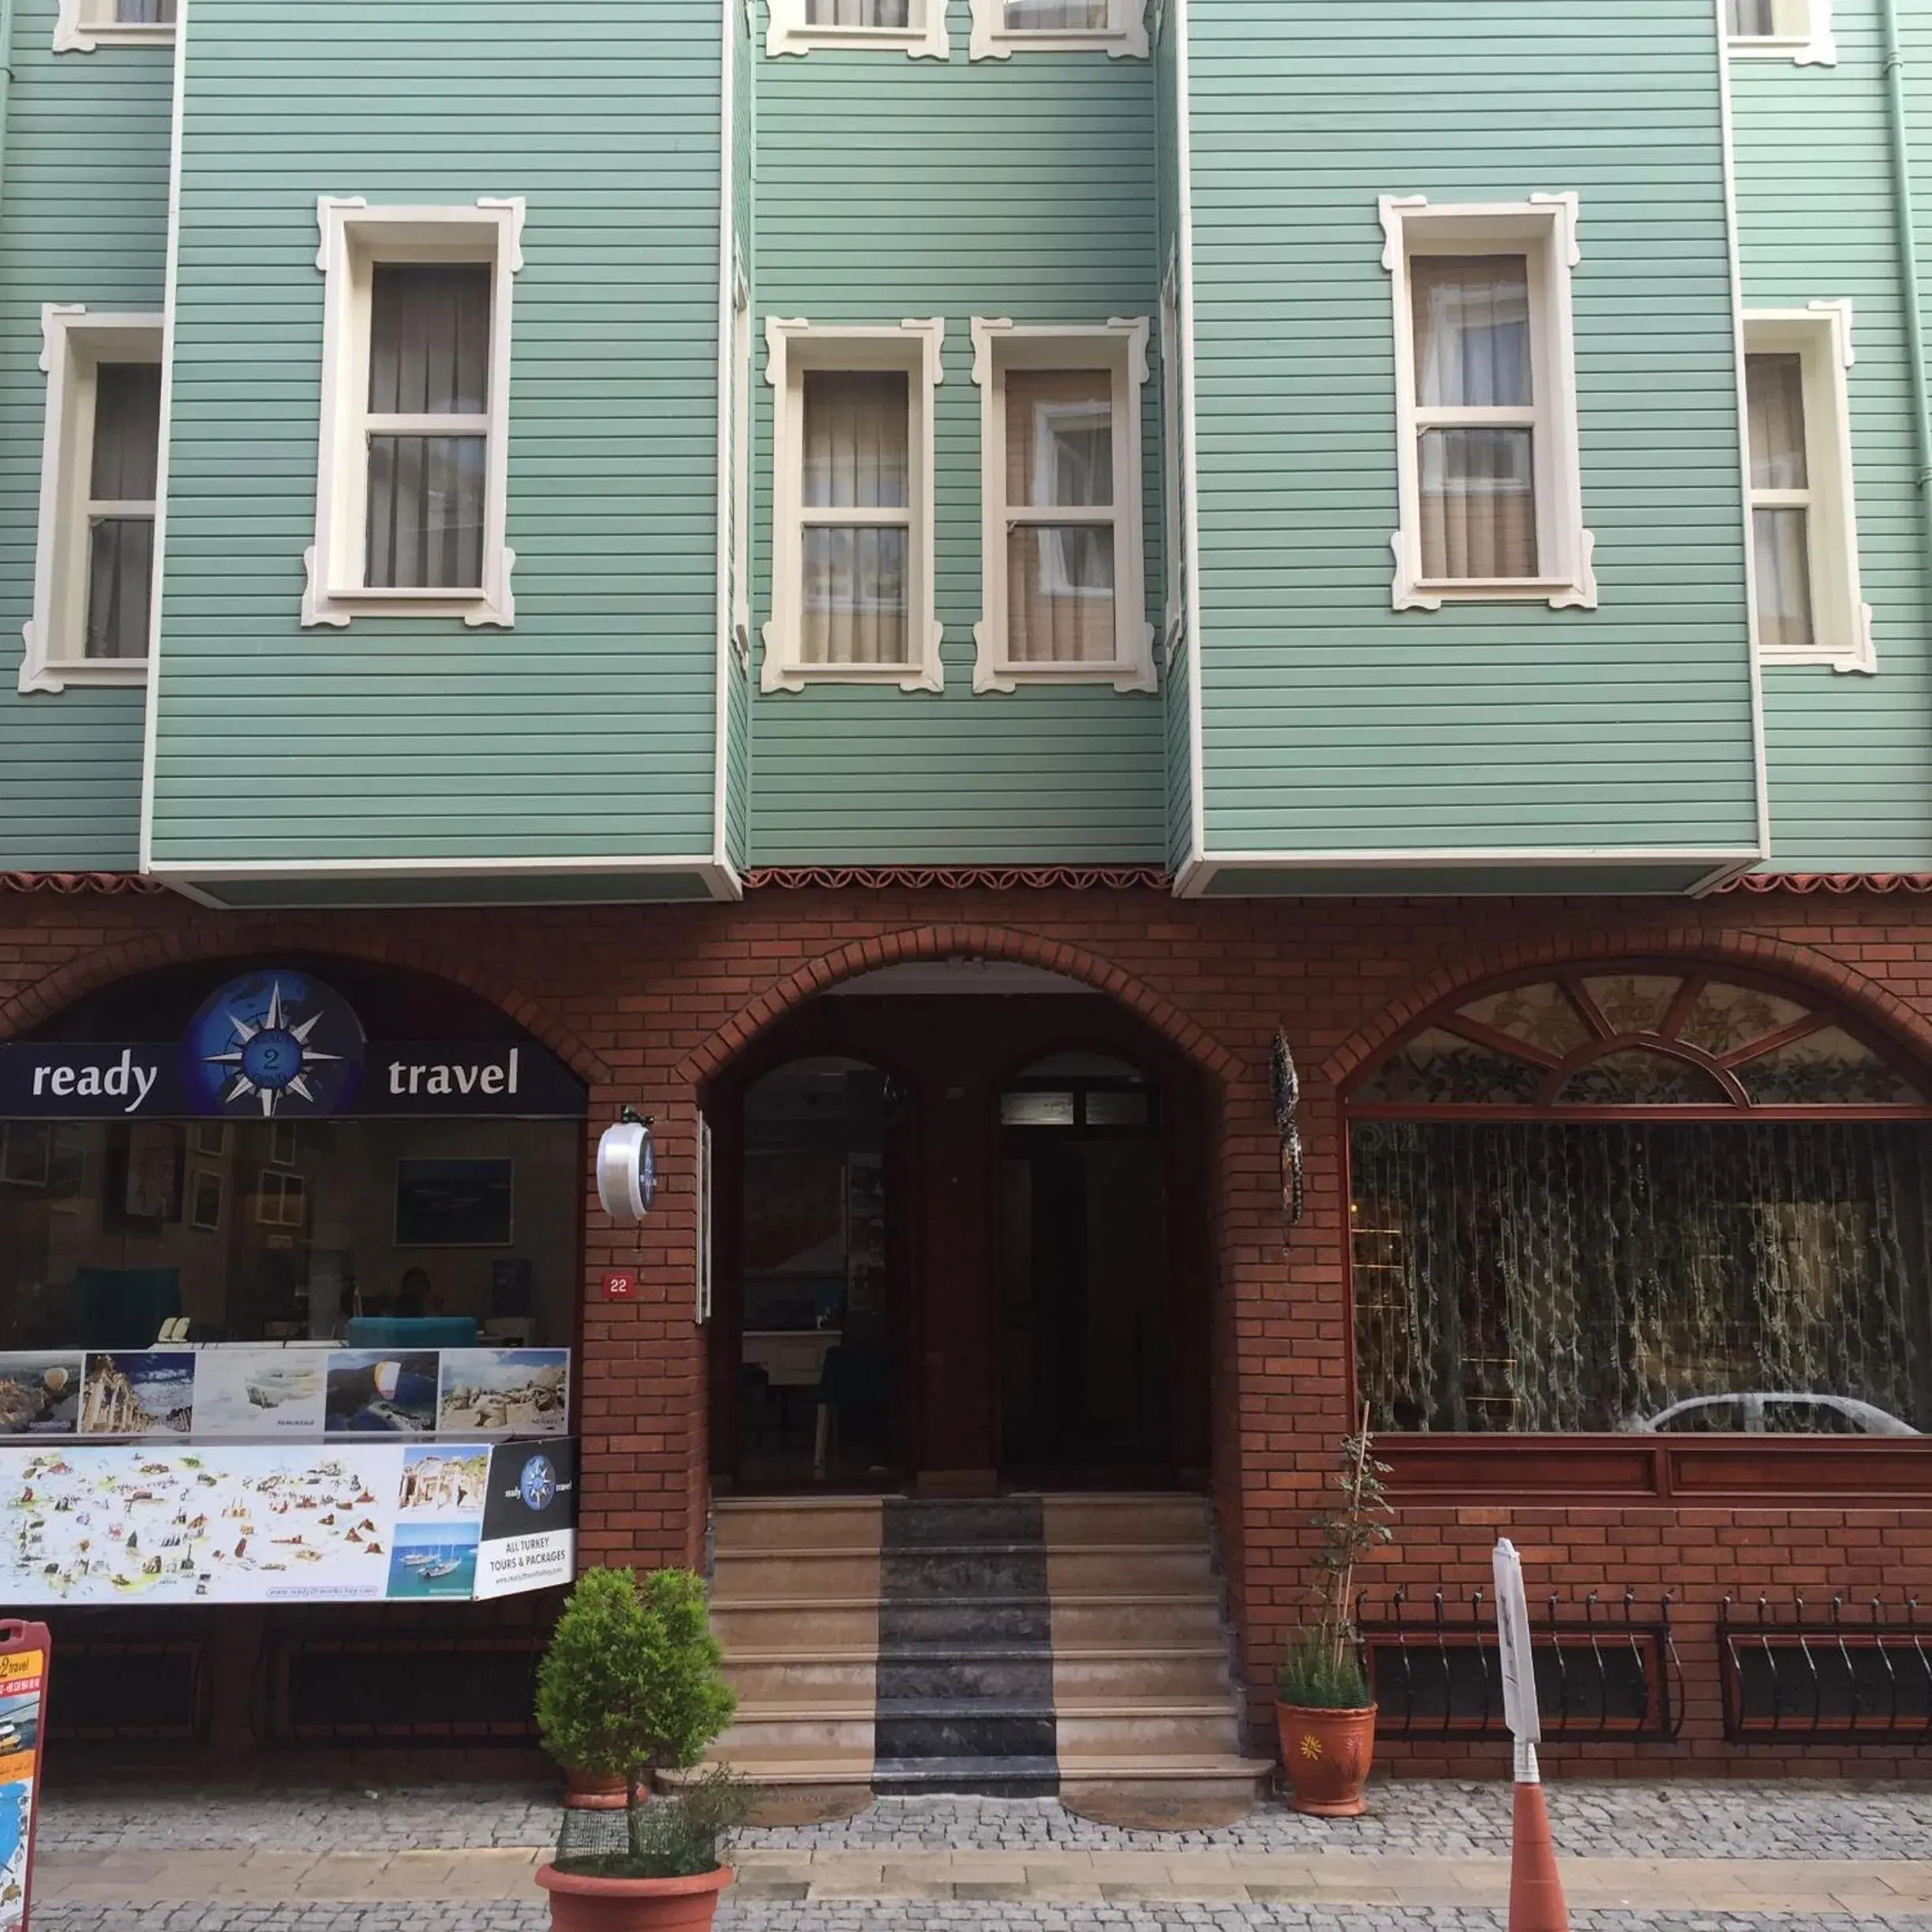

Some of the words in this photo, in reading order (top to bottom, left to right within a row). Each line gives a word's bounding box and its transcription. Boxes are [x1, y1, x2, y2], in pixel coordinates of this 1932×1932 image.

[32, 1049, 158, 1112] ready
[264, 1048, 279, 1069] 2
[388, 1047, 519, 1095] travel
[610, 1279, 627, 1293] 22
[506, 1541, 519, 1553] ALL
[521, 1537, 549, 1551] TURKEY
[490, 1557, 517, 1572] TOURS
[519, 1557, 524, 1567] &
[526, 1550, 566, 1565] PACKAGES
